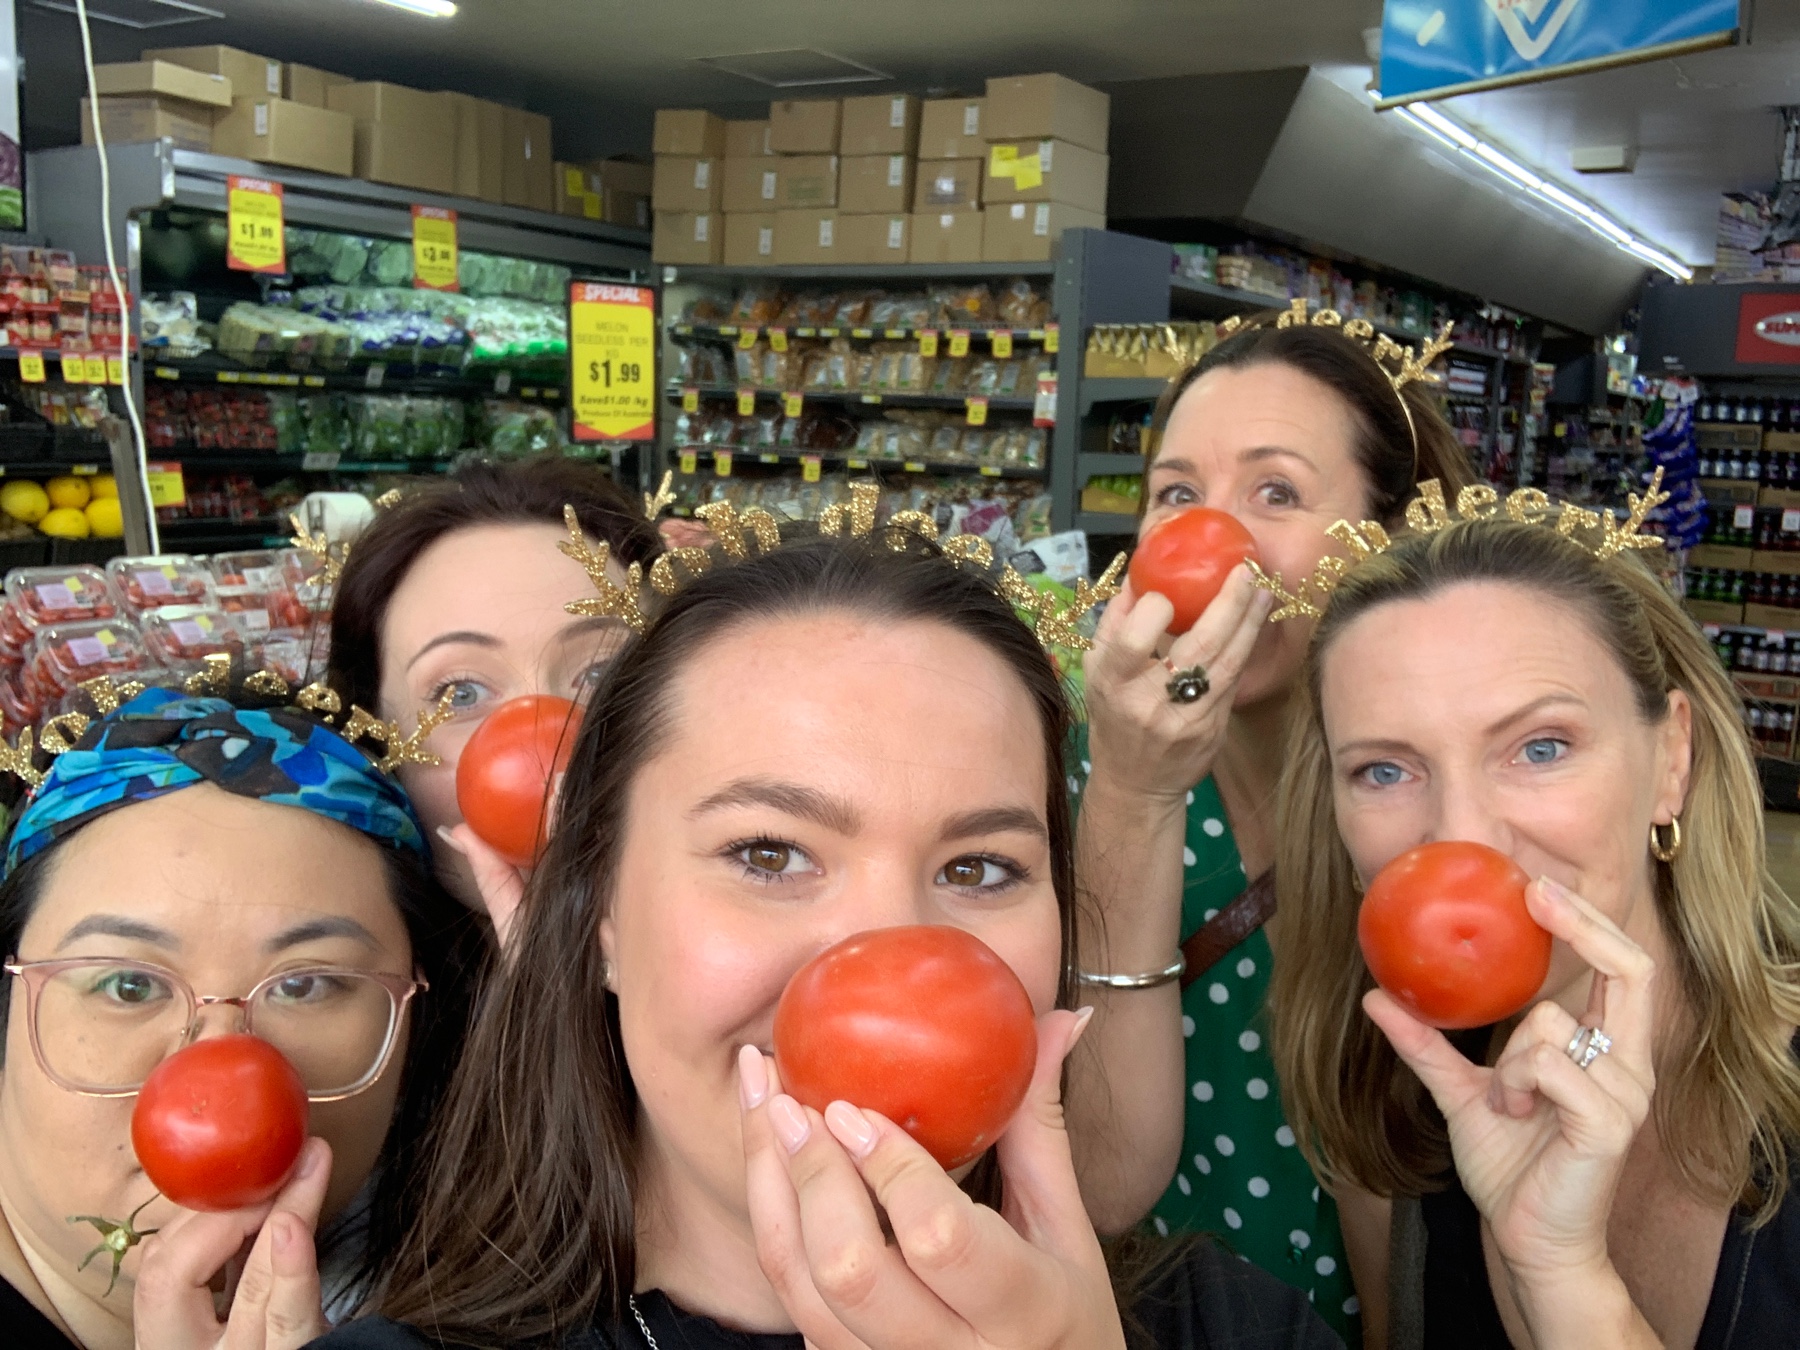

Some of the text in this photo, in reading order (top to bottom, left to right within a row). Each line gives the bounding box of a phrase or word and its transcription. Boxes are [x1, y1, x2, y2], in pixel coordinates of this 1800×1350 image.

[584, 283, 640, 303] SPECIAL
[595, 321, 629, 333] MELON
[575, 333, 649, 347] SEEDLESS PER
[589, 359, 641, 388] $1.99
[1405, 478, 1600, 535] deer
